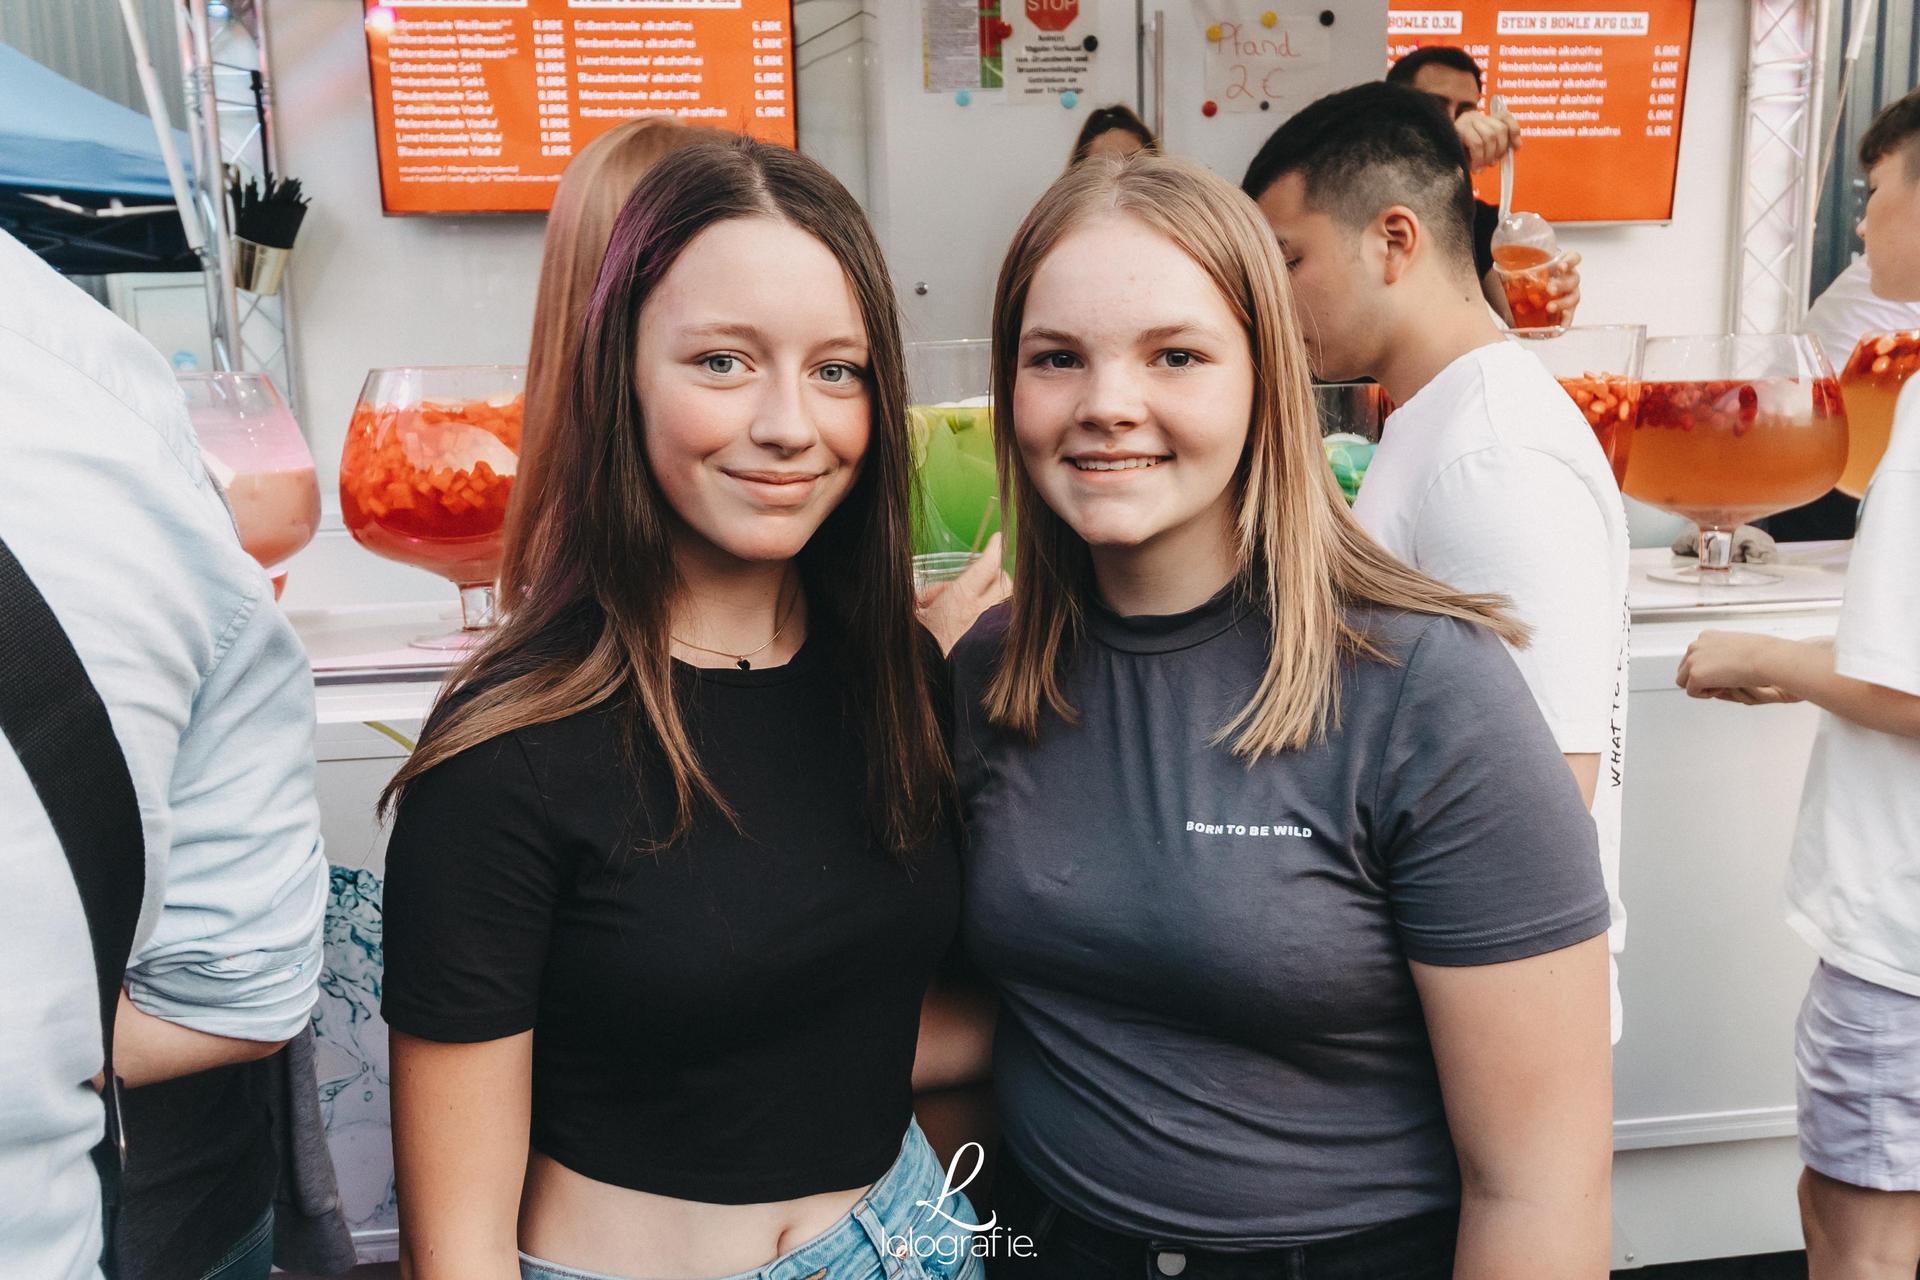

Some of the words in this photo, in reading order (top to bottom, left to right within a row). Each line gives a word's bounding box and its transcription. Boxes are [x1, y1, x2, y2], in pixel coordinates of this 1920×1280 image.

[1028, 0, 1076, 11] STOP
[642, 21, 693, 31] alkoholfrei
[1502, 16, 1536, 29] STEIN
[1551, 16, 1590, 29] BOWLE
[1594, 16, 1617, 29] AFG
[645, 38, 696, 48] alkoholfrei
[1218, 22, 1302, 57] Pfand
[1557, 46, 1602, 56] alkoholfrei
[652, 55, 704, 66] alkoholfrei
[1557, 62, 1603, 72] alkoholfrei
[651, 73, 702, 83] alkoholfrei
[1563, 78, 1607, 89] alkoholfrei
[649, 90, 700, 100] alkoholfrei
[1560, 95, 1603, 105] alkoholfrei
[676, 107, 727, 119] alkoholfrei
[1554, 111, 1599, 120] alkoholfrei
[1577, 127, 1621, 136] alkoholfrei
[1611, 718, 1622, 788] WHAT
[1186, 821, 1223, 834] BORN
[1227, 825, 1246, 836] TO
[1249, 826, 1269, 836] BE
[1273, 826, 1312, 838] WILD
